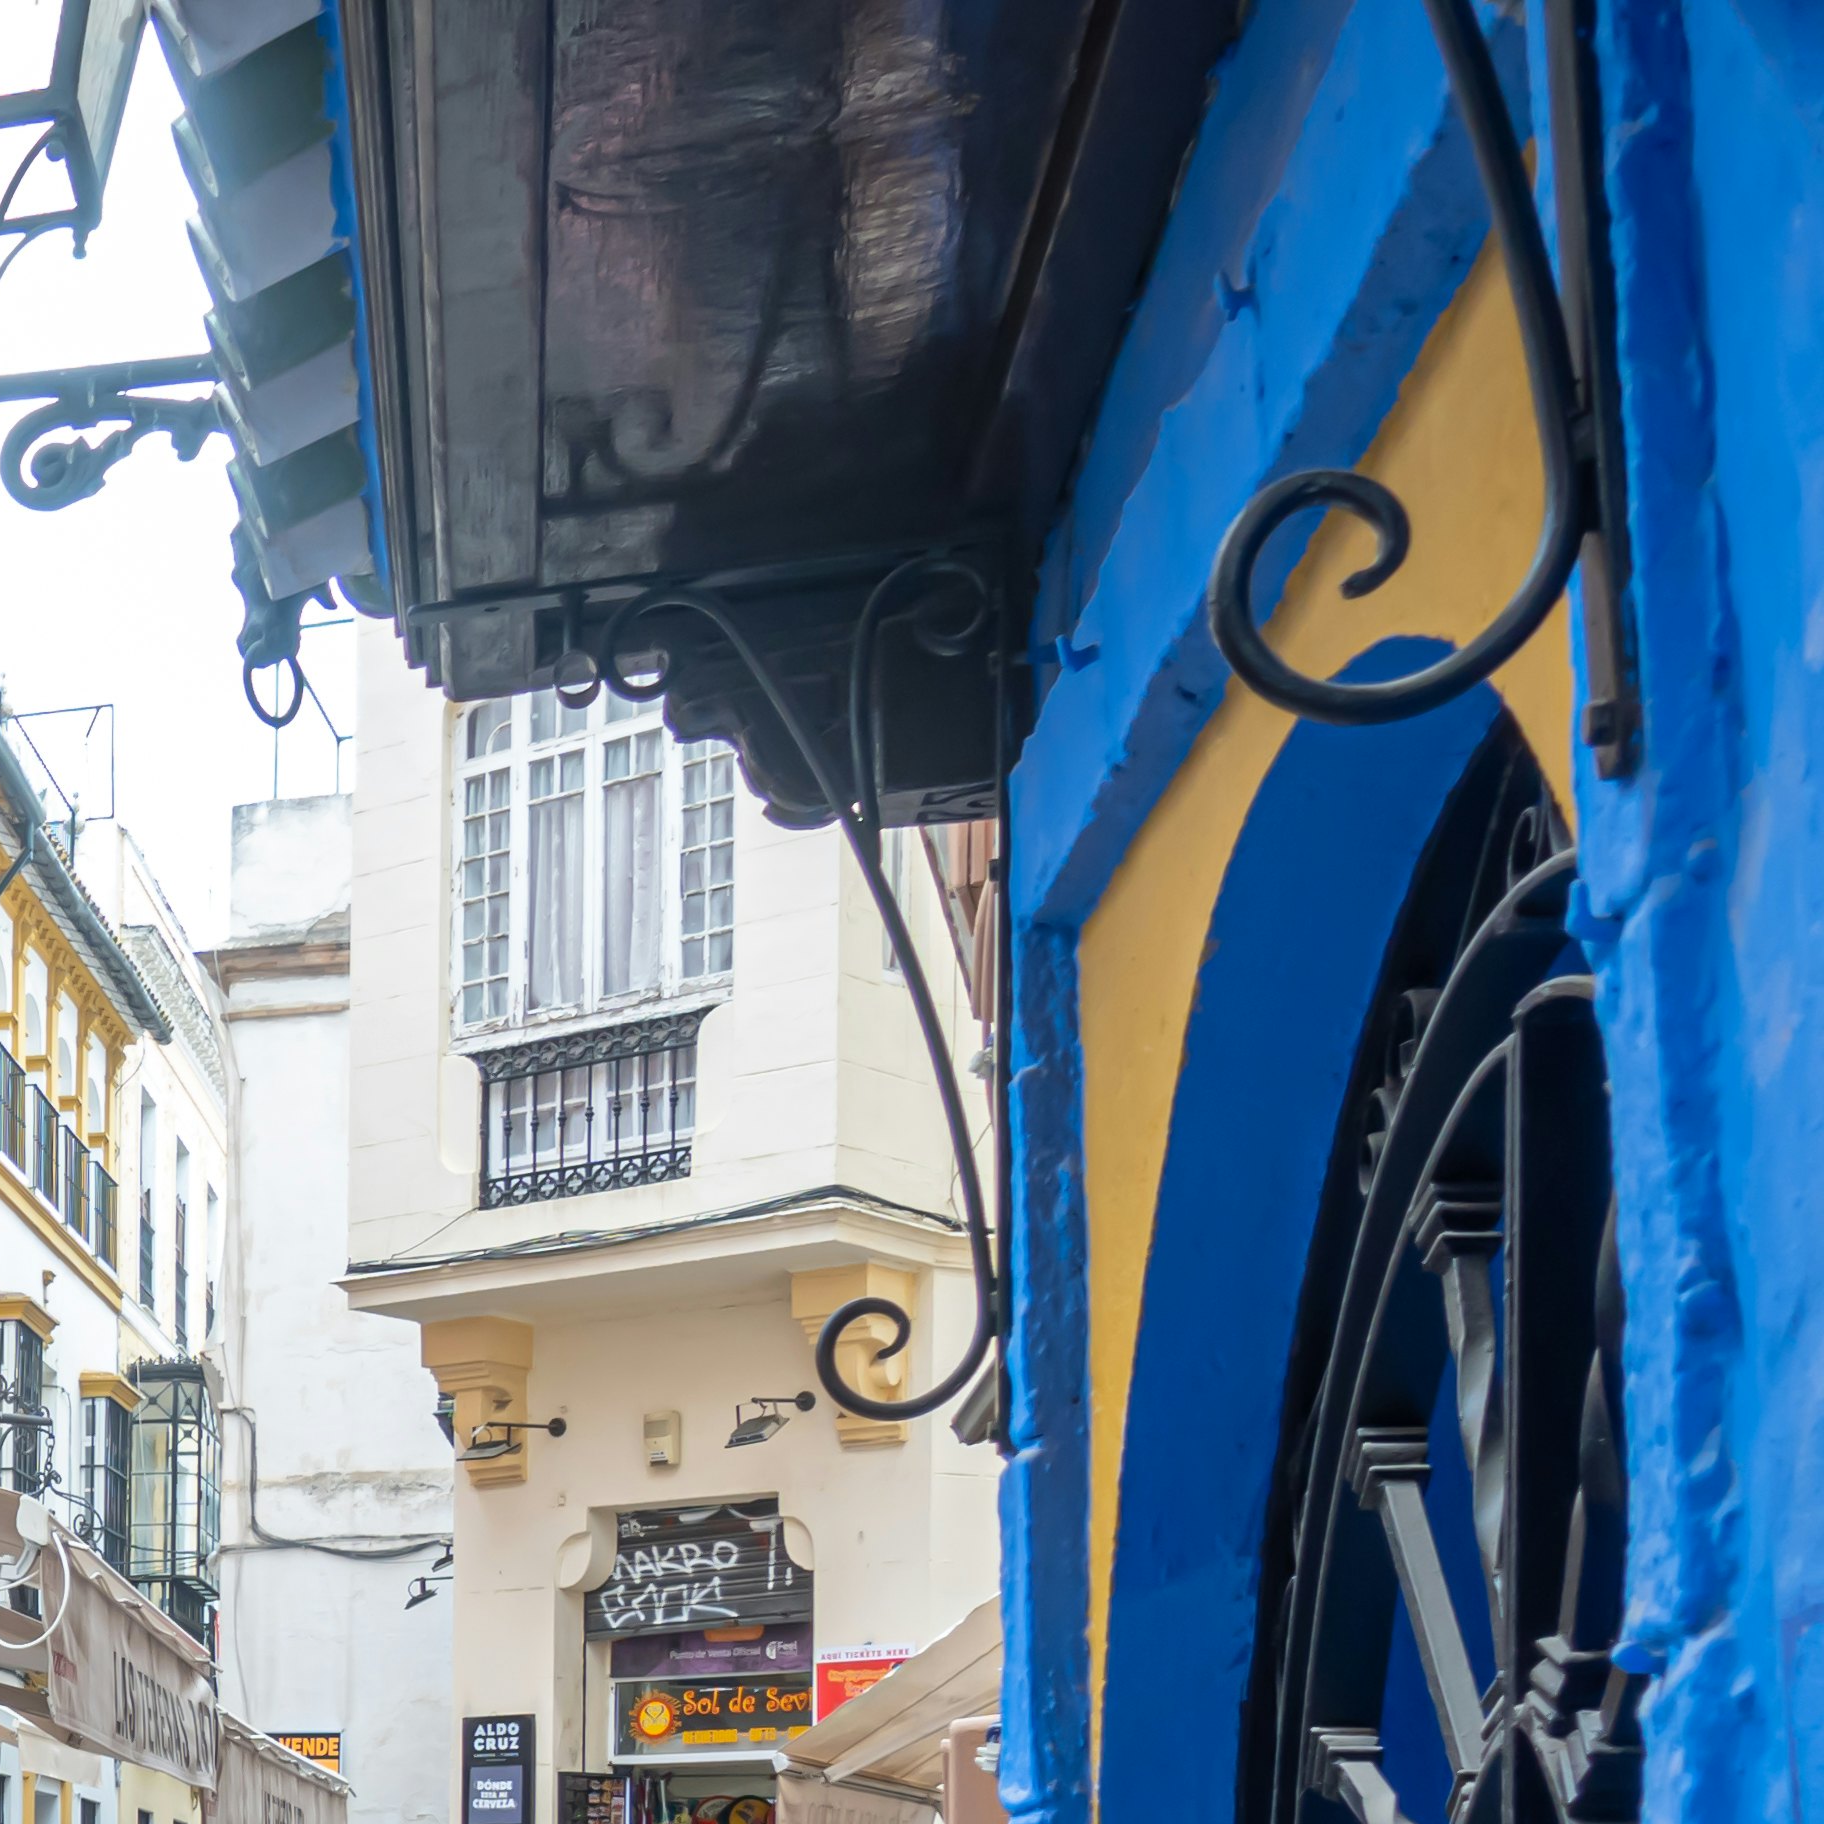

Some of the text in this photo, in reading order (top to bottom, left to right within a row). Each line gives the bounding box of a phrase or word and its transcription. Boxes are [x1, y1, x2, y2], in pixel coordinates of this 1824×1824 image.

[683, 1687, 720, 1715] Sol
[729, 1686, 756, 1713] de
[474, 1722, 519, 1736] ALDO
[473, 1736, 519, 1751] CRUZ
